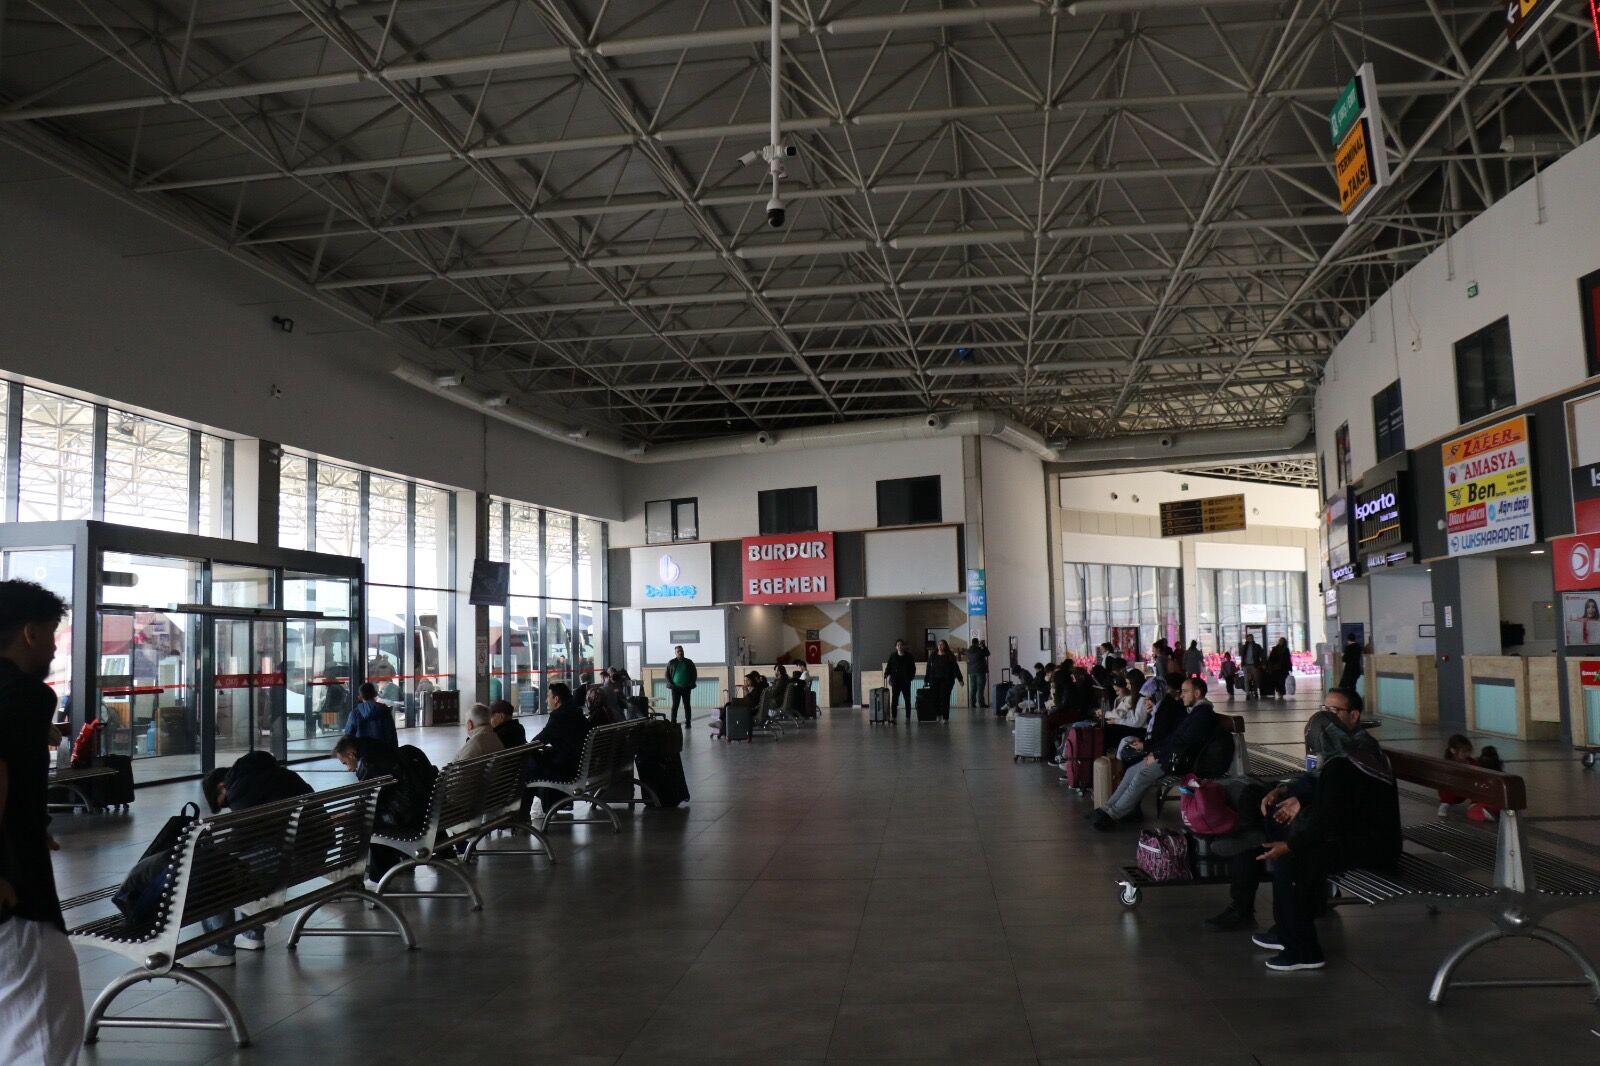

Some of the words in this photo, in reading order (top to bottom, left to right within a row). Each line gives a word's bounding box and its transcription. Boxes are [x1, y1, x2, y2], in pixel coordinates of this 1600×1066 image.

[1465, 450, 1517, 480] AMASYA
[1467, 482, 1496, 502] Ben
[1355, 493, 1396, 522] Isparta
[748, 541, 827, 562] BURDUR
[749, 575, 827, 595] EGEMEN
[970, 595, 984, 606] WC
